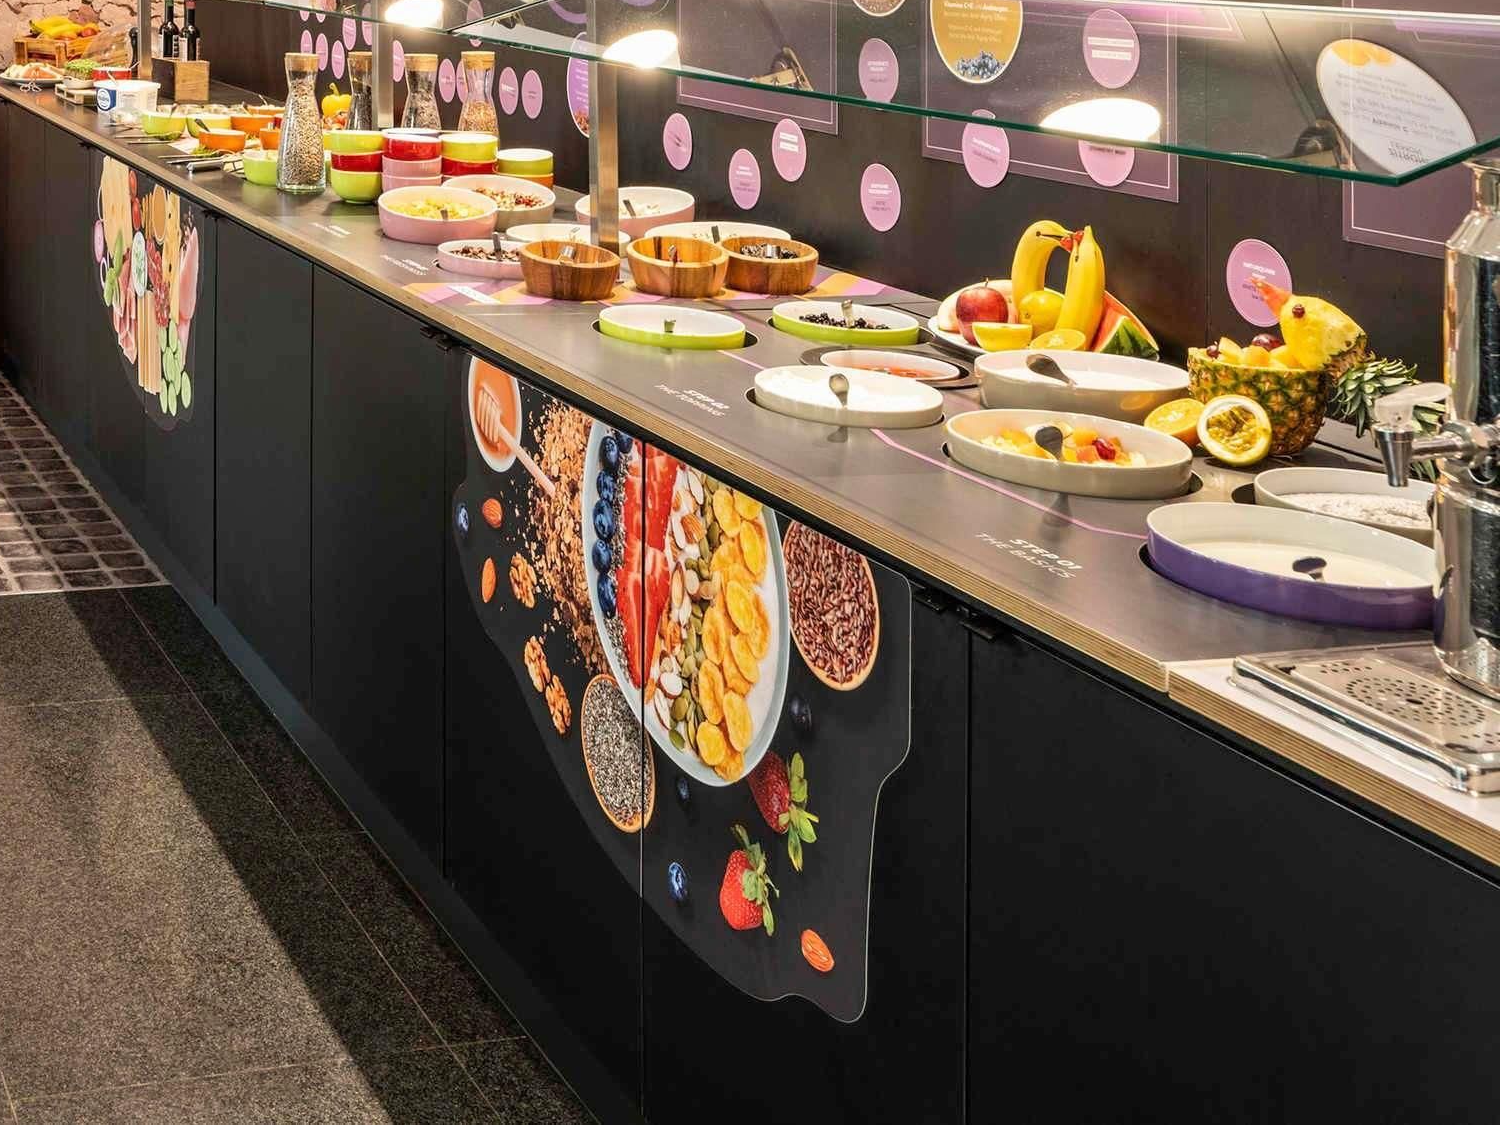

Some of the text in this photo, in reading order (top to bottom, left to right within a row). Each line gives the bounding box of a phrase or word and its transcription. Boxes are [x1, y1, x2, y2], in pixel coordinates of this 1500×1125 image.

[682, 389, 715, 403] STEP
[974, 533, 1077, 578] THE BASICS
[1009, 539, 1083, 571] STEP 01
